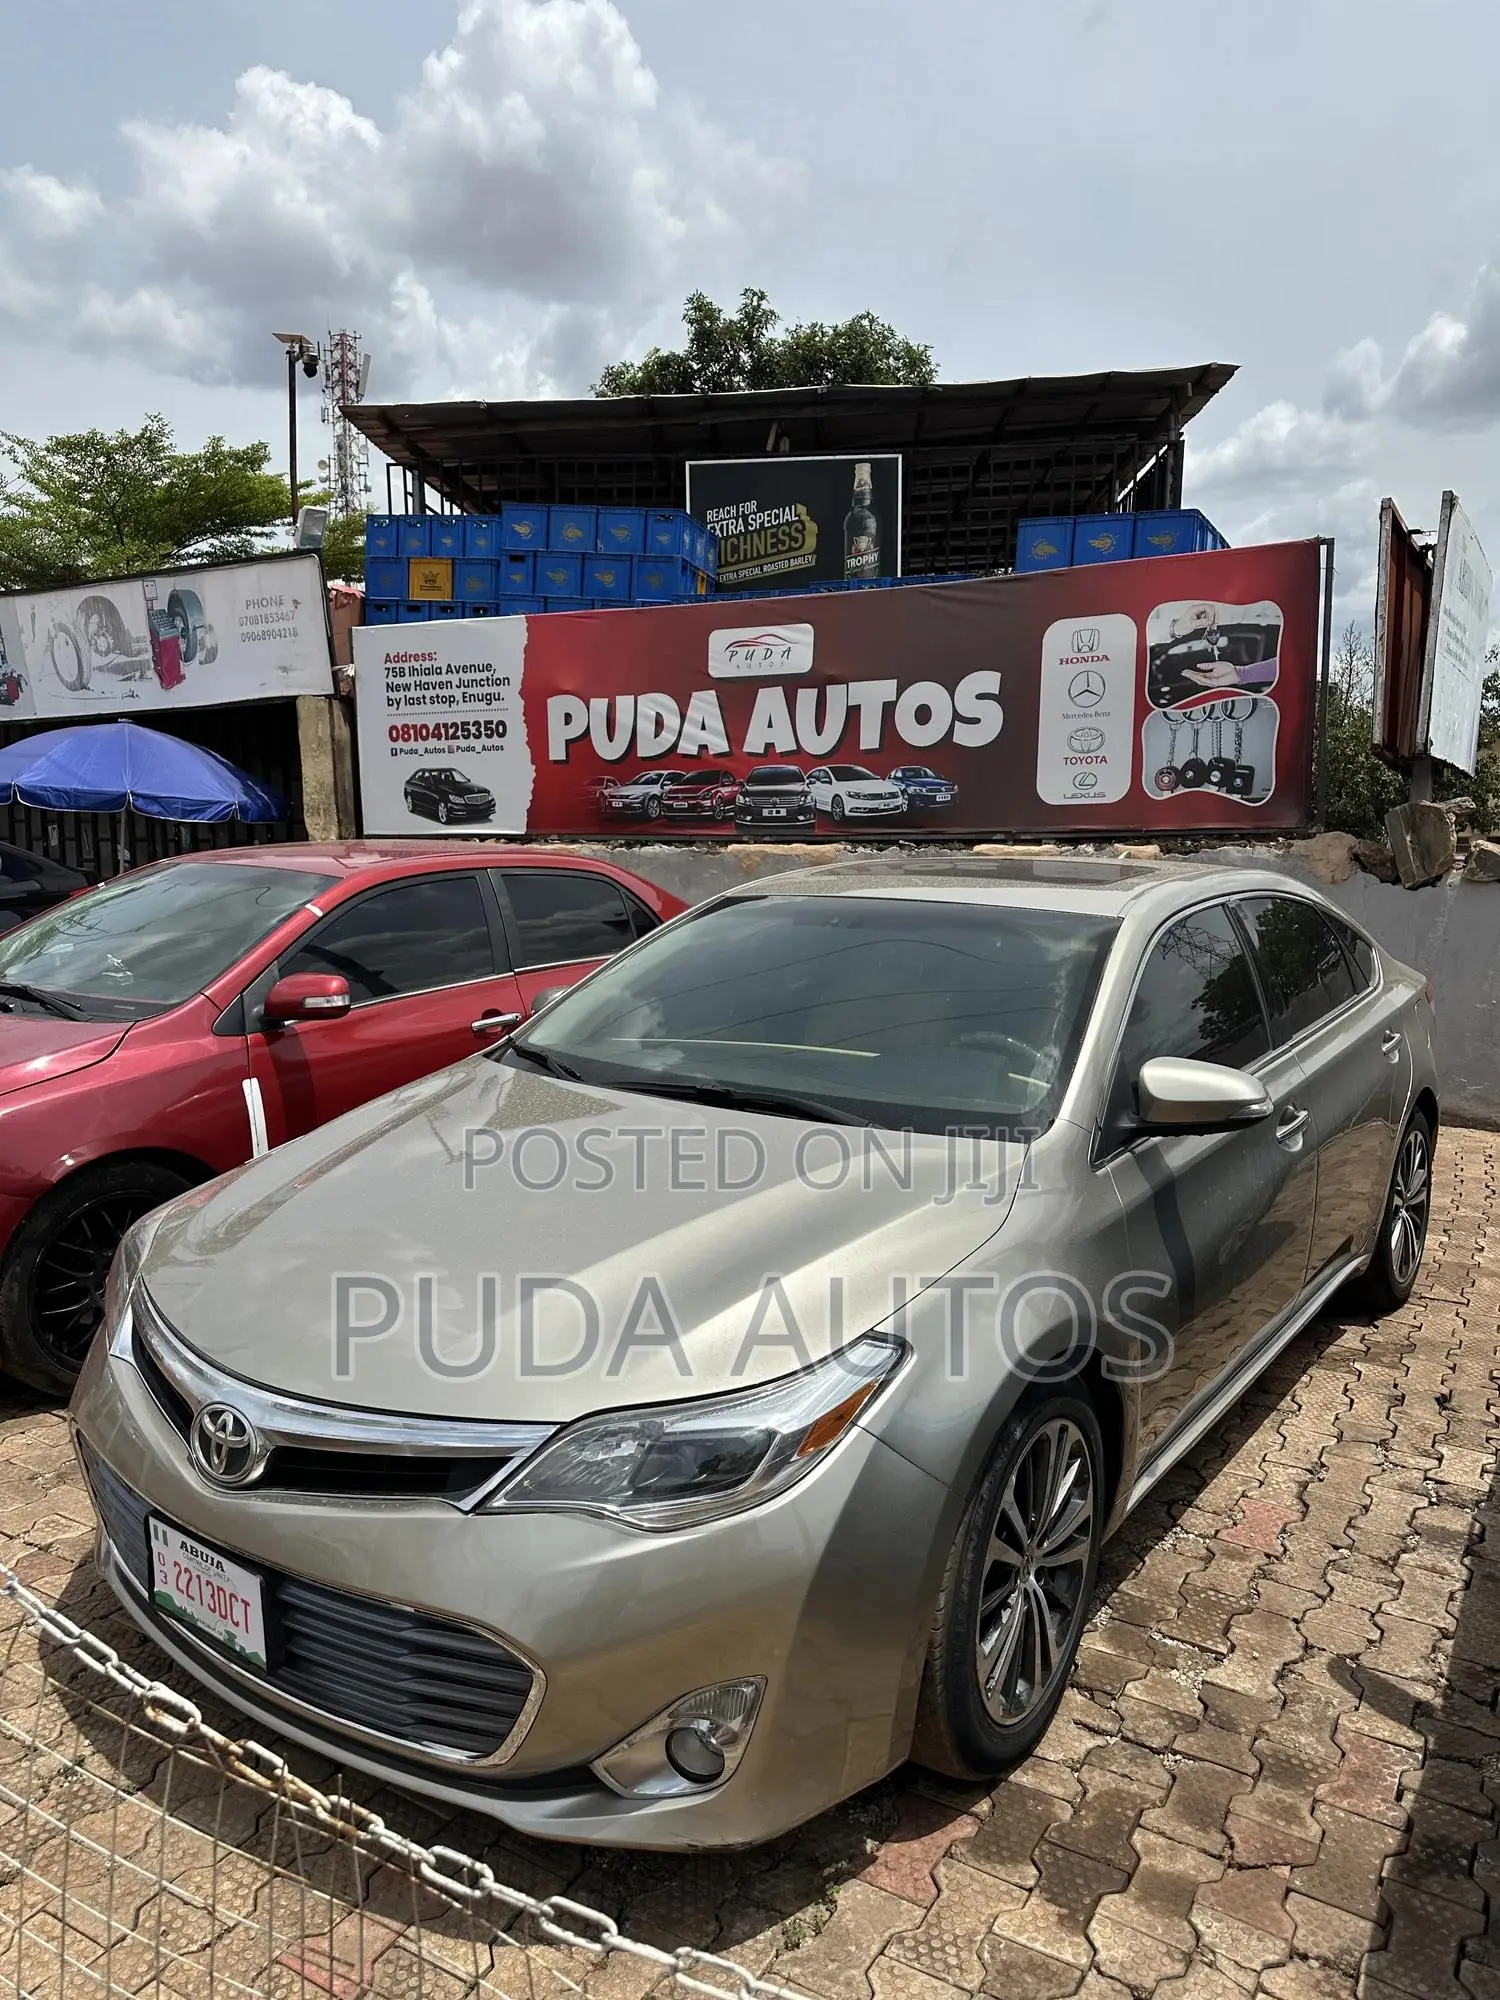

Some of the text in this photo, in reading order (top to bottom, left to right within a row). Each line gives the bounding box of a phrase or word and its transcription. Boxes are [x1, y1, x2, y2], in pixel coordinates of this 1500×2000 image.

[706, 500, 757, 523] REACH FOR
[707, 504, 799, 537] EXTRA SPECIAL
[719, 521, 803, 565] ICHNESS
[846, 551, 879, 568] TROPHY
[719, 555, 813, 583] EXTRA SPECIAL ROASTED BARLEY
[245, 595, 285, 610] PHONE
[384, 651, 438, 664] Address:
[727, 646, 792, 662] PUDA
[1059, 654, 1111, 665] HONDA
[384, 662, 497, 679] 75B Ihiala Avenue,
[386, 674, 511, 693] New Haven Junction
[387, 691, 505, 710] by last stop, Enugu.
[547, 670, 1005, 761] PUDA AUTOS
[1062, 710, 1111, 720] Mercedes-Benz
[388, 720, 507, 742] 08104125350
[399, 743, 505, 757] Puda_Autos Puda_Autos
[1063, 755, 1108, 766] TOYOTA
[1063, 791, 1106, 800] LEXUS
[173, 1560, 251, 1634] 2213DCT
